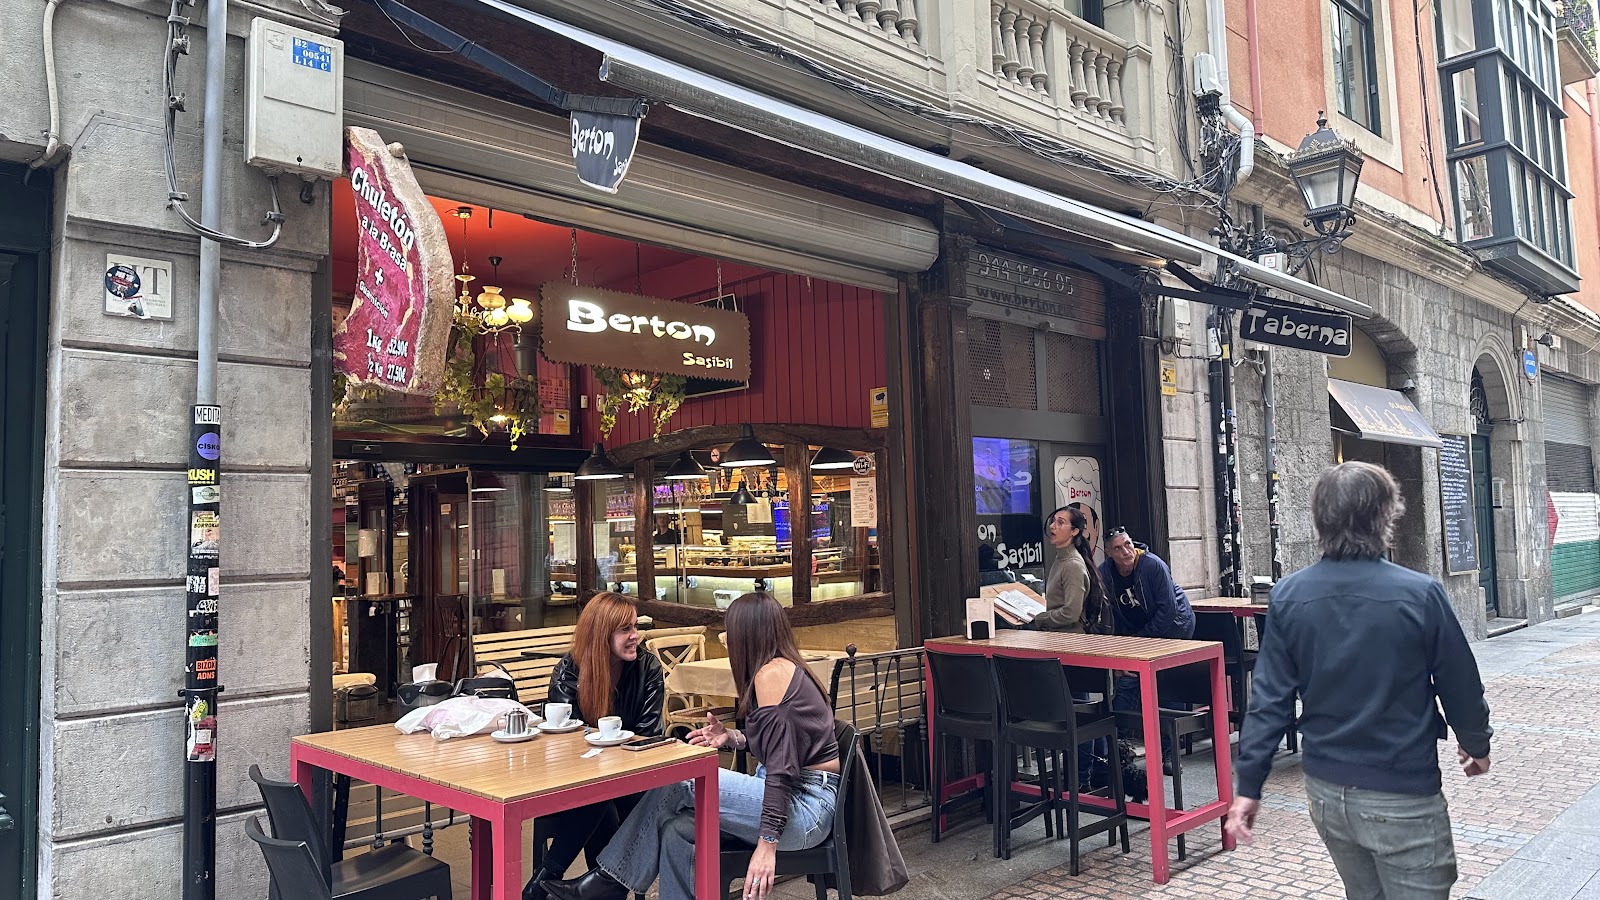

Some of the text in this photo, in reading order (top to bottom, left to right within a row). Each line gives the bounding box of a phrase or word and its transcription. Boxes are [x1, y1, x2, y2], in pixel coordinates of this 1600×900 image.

[294, 38, 331, 55] B2 06
[302, 49, 330, 63] 00541
[295, 55, 328, 71] L14 C
[571, 118, 615, 160] Berton
[352, 166, 415, 251] Chuletón
[361, 215, 407, 272] a la Brasa
[978, 253, 1010, 280] 944
[1056, 273, 1074, 295] 05
[567, 299, 716, 347] Berton
[1247, 307, 1348, 346] Taberna
[682, 352, 733, 370] Sasibil
[187, 468, 215, 481] KUSH
[977, 524, 997, 543] on
[997, 541, 1043, 570] Sasibil
